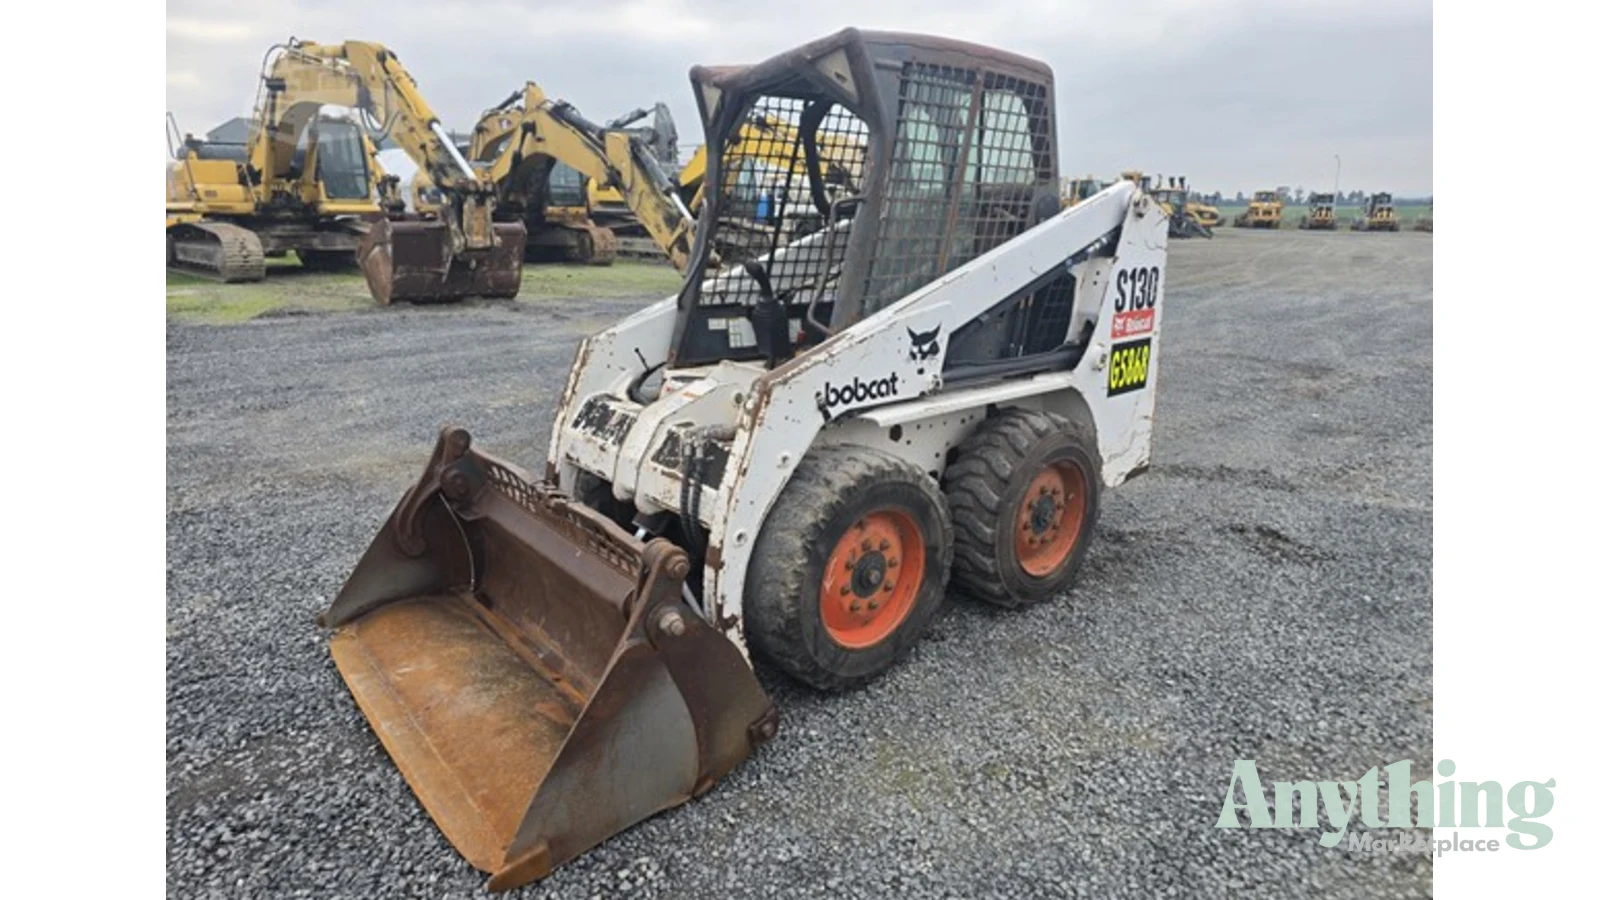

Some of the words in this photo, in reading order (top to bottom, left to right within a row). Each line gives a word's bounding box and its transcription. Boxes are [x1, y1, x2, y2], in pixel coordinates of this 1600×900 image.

[1115, 266, 1159, 312] S130
[825, 371, 898, 407] bobcat
[1110, 345, 1149, 389] G5868
